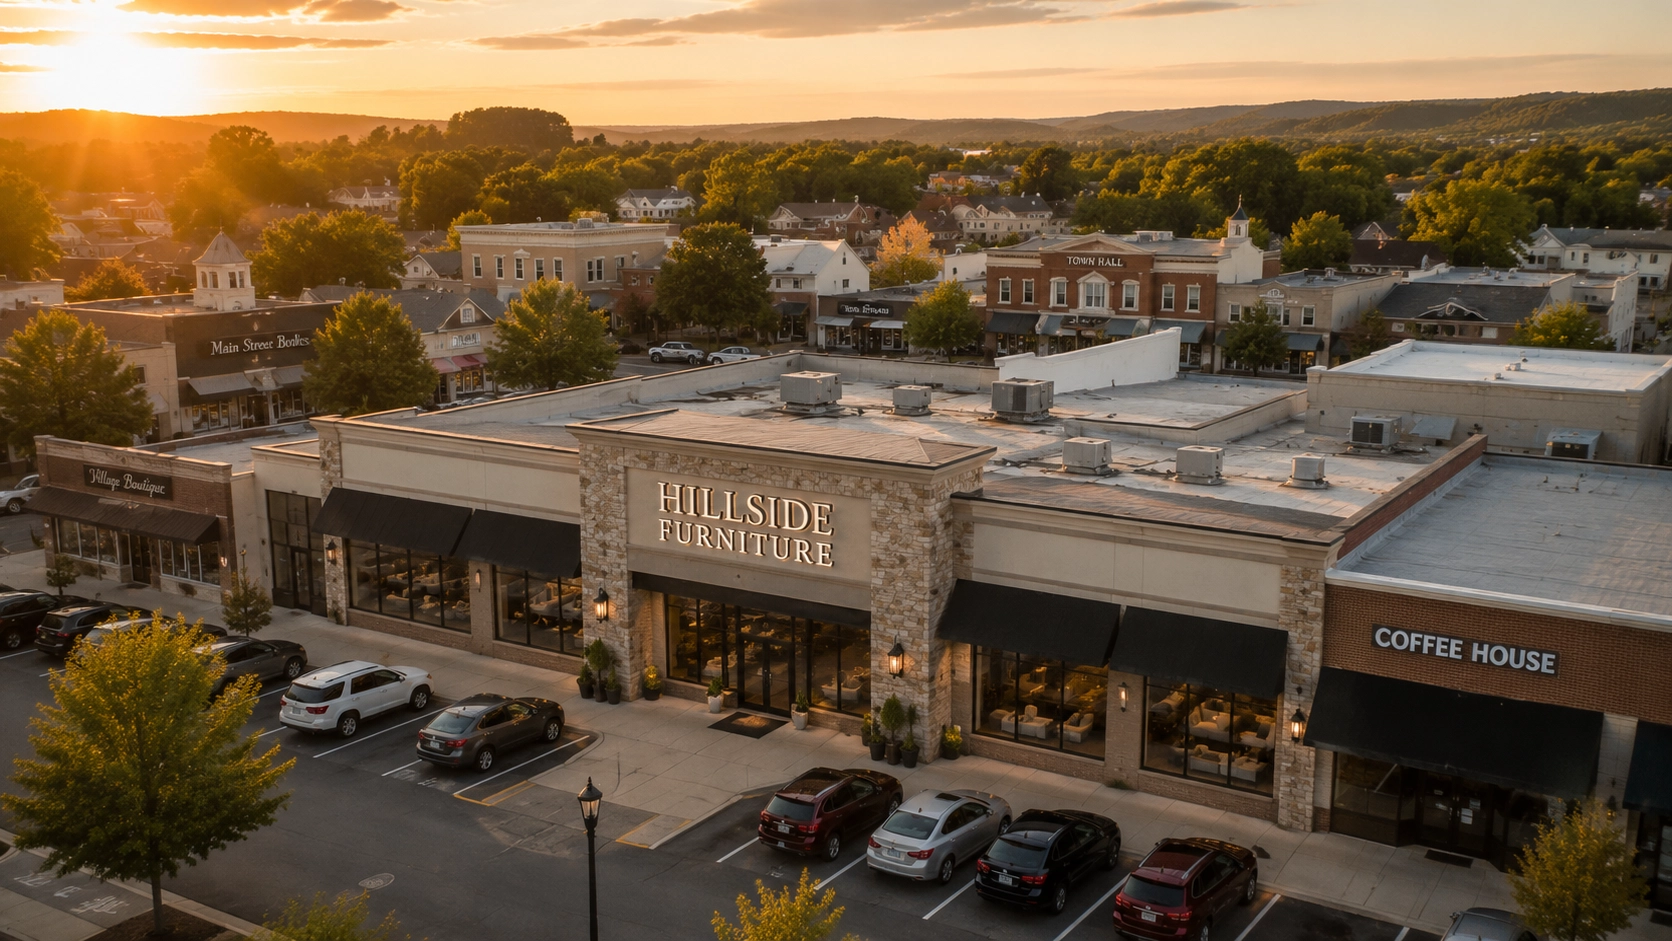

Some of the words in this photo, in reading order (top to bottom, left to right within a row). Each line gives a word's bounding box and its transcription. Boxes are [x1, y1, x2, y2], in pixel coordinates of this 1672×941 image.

[1066, 256, 1096, 266] TOWN
[210, 340, 239, 356] Main
[657, 481, 834, 537] HILLSIDE
[658, 518, 835, 567] FURNITURE
[1374, 627, 1463, 660] COFFEE
[1471, 642, 1556, 674] HOUSE
